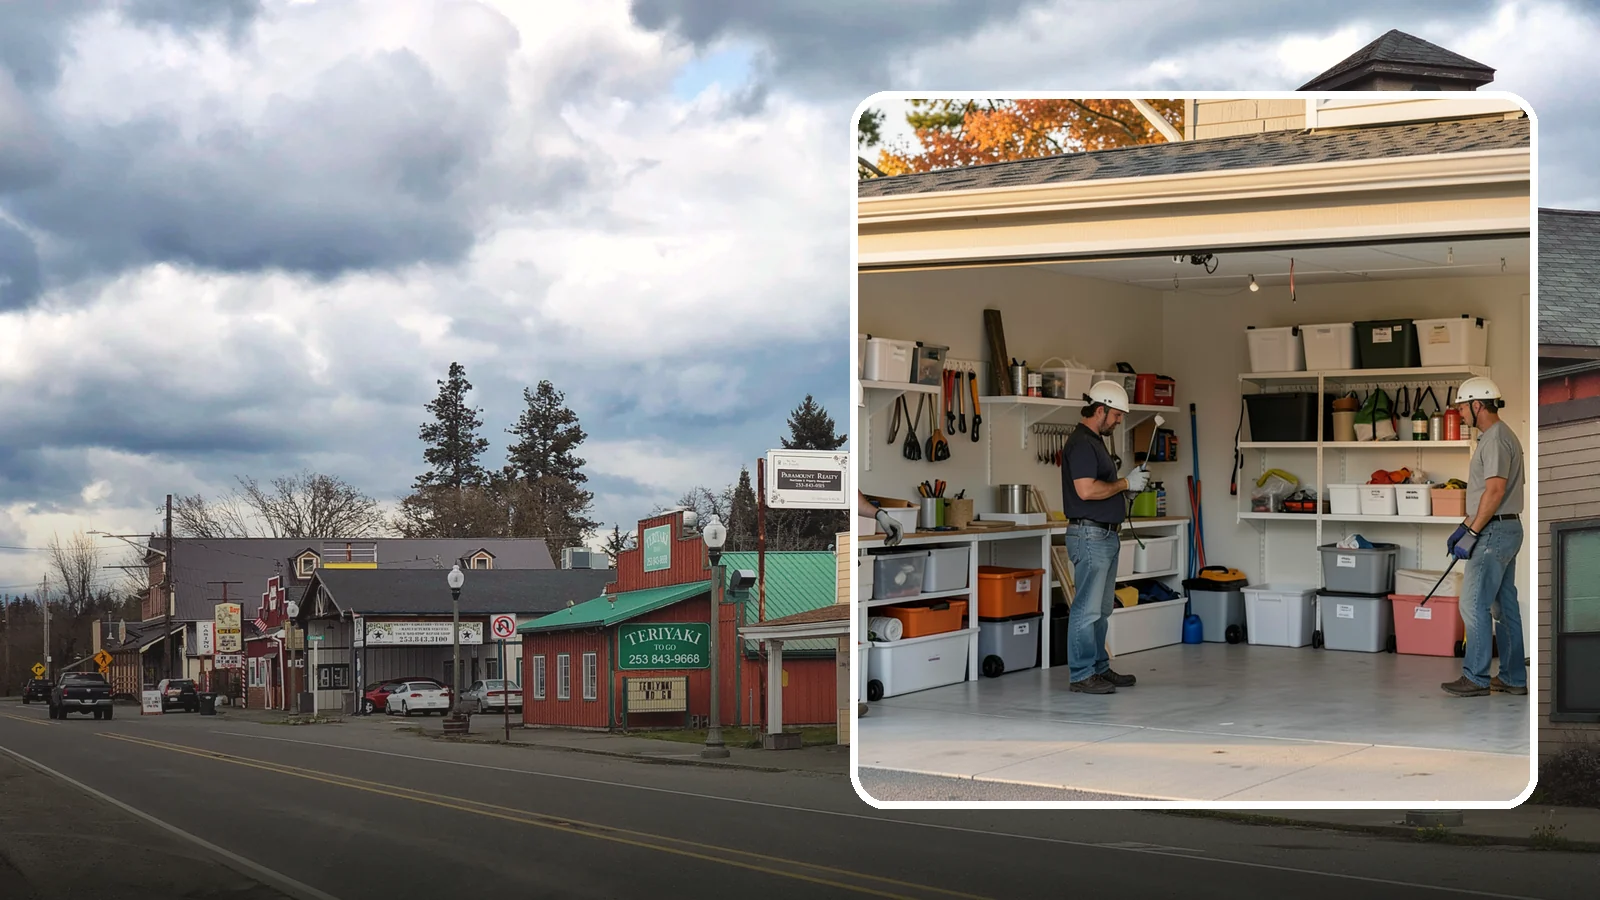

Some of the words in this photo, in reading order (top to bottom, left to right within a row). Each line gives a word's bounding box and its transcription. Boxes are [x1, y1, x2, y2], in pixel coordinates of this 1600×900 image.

[781, 471, 815, 479] PARAMOUNT
[817, 472, 839, 480] REALTY
[624, 627, 702, 646] TERIYAKI
[629, 654, 649, 665] 253
[651, 653, 700, 664] 843-9668
[639, 681, 673, 690] TERIYAKI
